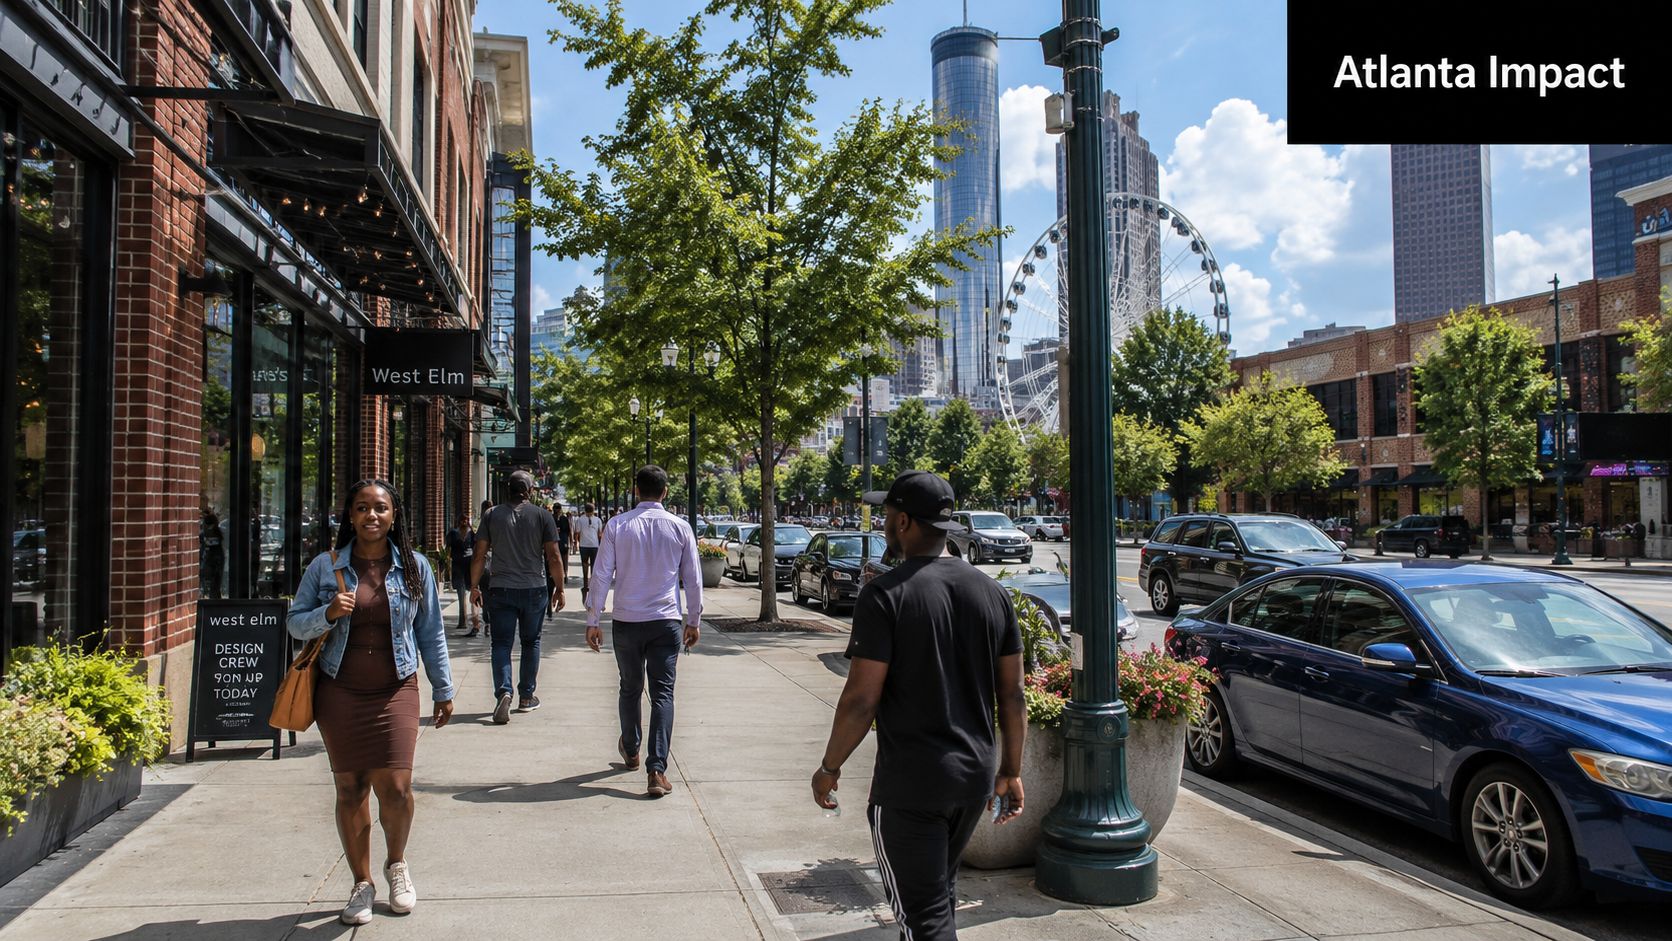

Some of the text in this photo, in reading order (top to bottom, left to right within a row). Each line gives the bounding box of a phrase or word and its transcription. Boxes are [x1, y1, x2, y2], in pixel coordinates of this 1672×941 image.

[372, 367, 465, 385] West Elm
[210, 613, 277, 626] west elm
[215, 643, 264, 655] DESIGN
[219, 657, 259, 669] CREW
[214, 688, 258, 699] TODAY
